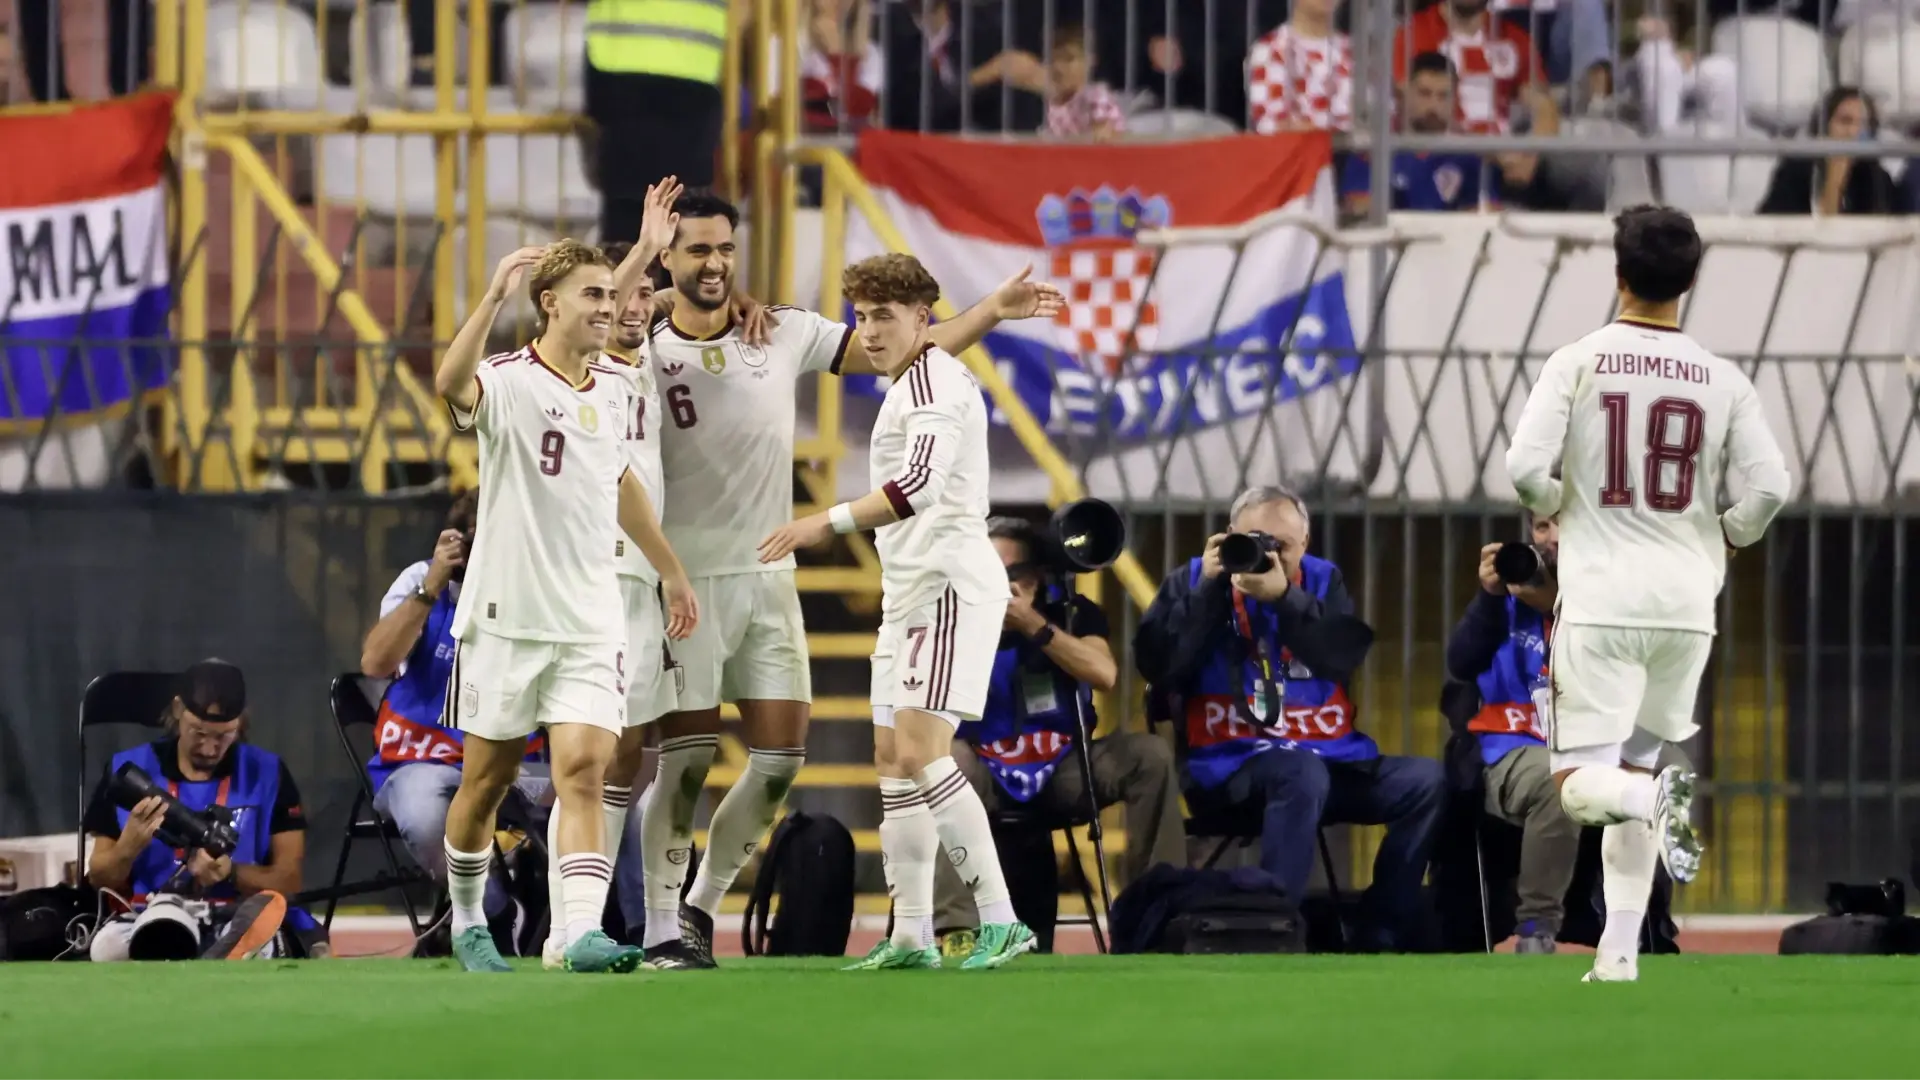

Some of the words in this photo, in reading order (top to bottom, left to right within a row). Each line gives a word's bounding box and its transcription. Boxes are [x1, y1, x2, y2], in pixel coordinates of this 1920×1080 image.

[1594, 353, 1710, 386] ZUBIMENDI
[666, 384, 697, 429] 6
[540, 430, 566, 477] 9
[1598, 392, 1706, 514] 18
[907, 626, 928, 668] 7
[379, 719, 464, 758] PHO
